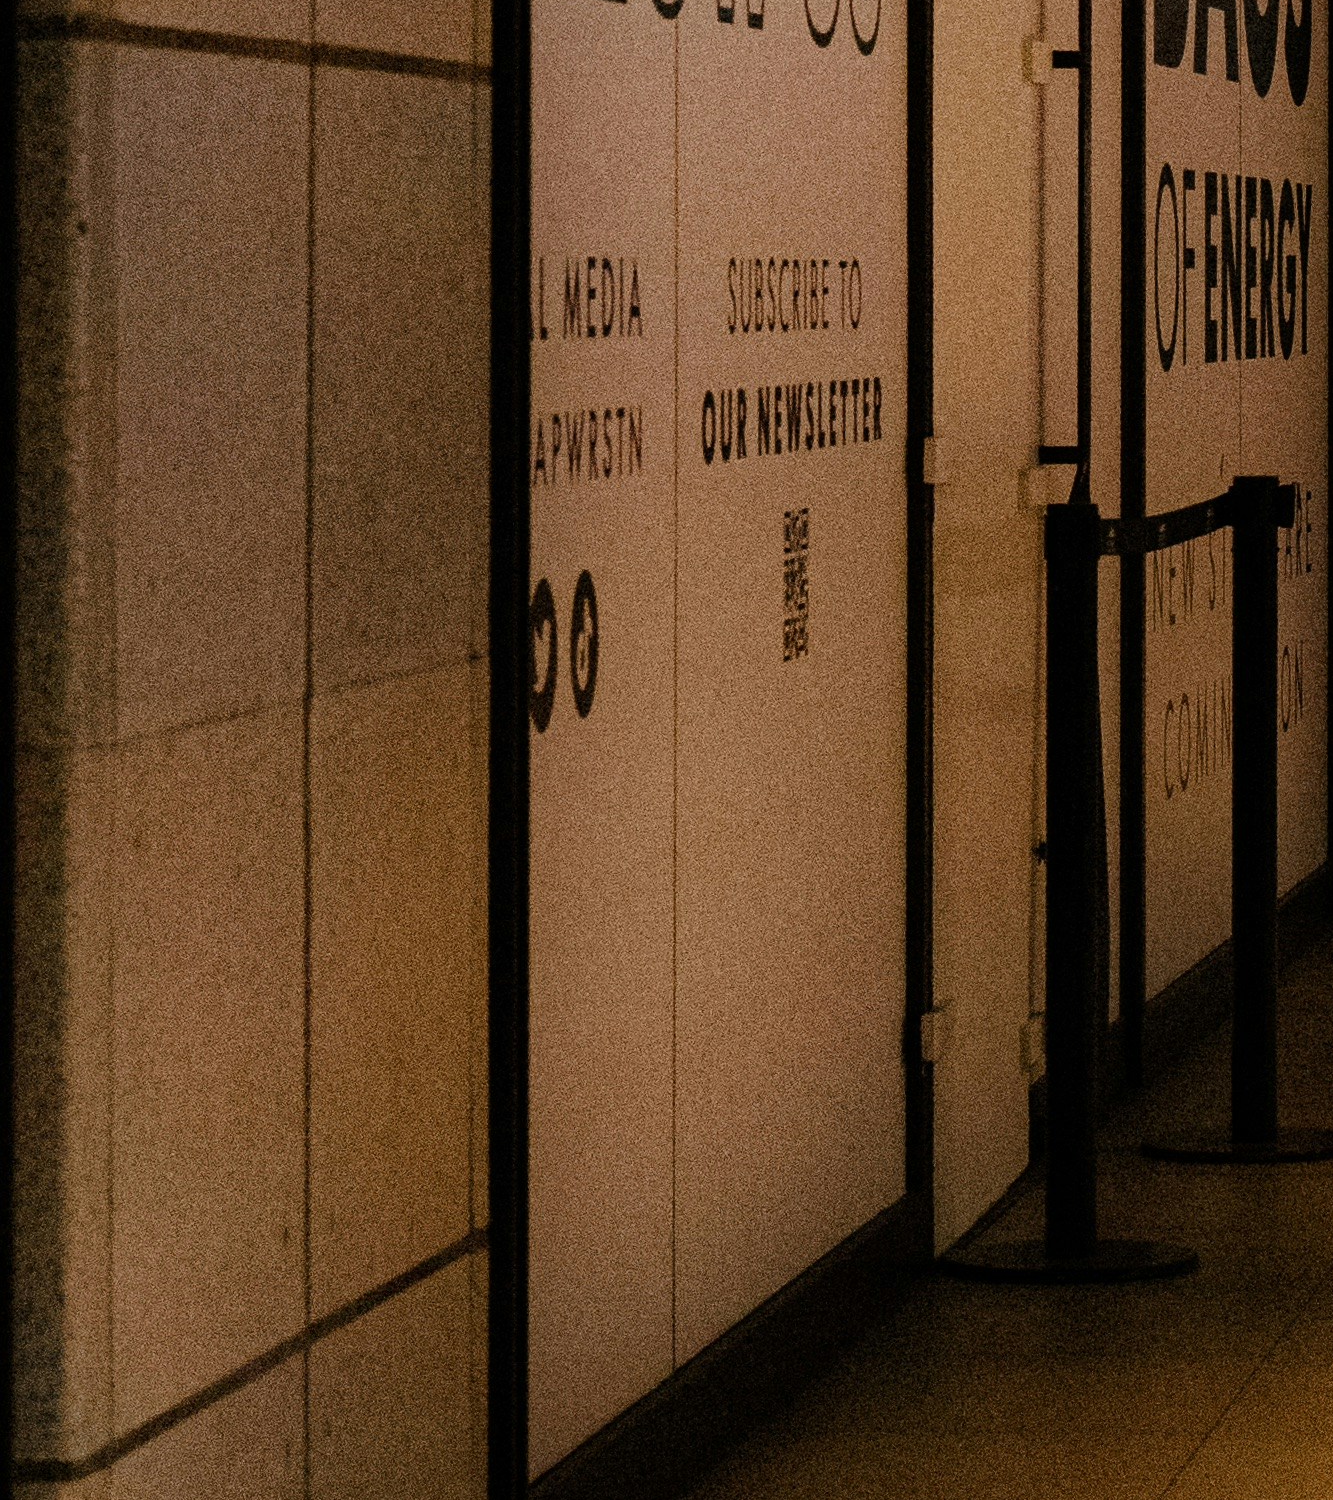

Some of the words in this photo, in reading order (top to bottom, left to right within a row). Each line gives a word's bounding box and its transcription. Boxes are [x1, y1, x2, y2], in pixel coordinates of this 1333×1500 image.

[563, 256, 643, 340] MEDIA
[728, 256, 830, 335] SUBSCRIBE
[839, 258, 863, 330] TO
[1153, 161, 1197, 372] OF
[1204, 171, 1314, 365] ENERGY
[533, 404, 643, 487] APWRSTN
[701, 388, 748, 466] OUR
[757, 376, 883, 457] NEWSLETTER
[1163, 676, 1234, 800] COMIN
[1280, 640, 1304, 733] ON
